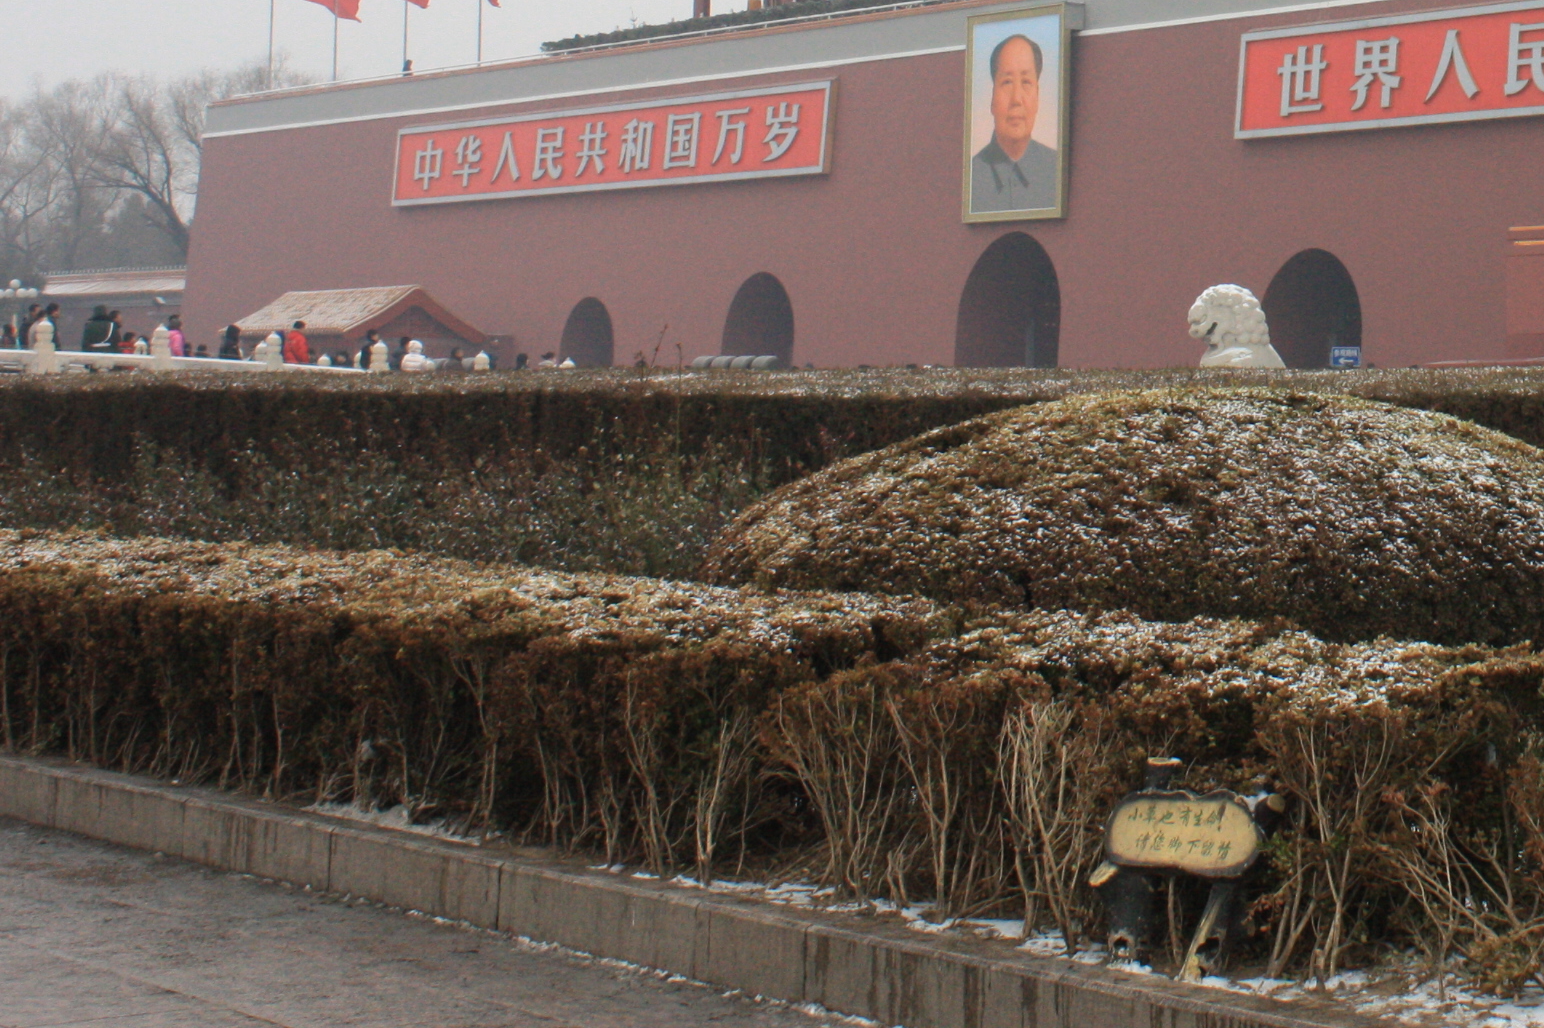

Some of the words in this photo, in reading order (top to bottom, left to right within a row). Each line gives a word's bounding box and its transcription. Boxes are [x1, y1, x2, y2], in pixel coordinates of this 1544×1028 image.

[412, 101, 801, 190] 中华人民共和国万岁
[1136, 832, 1231, 860] 请您脚下留情
